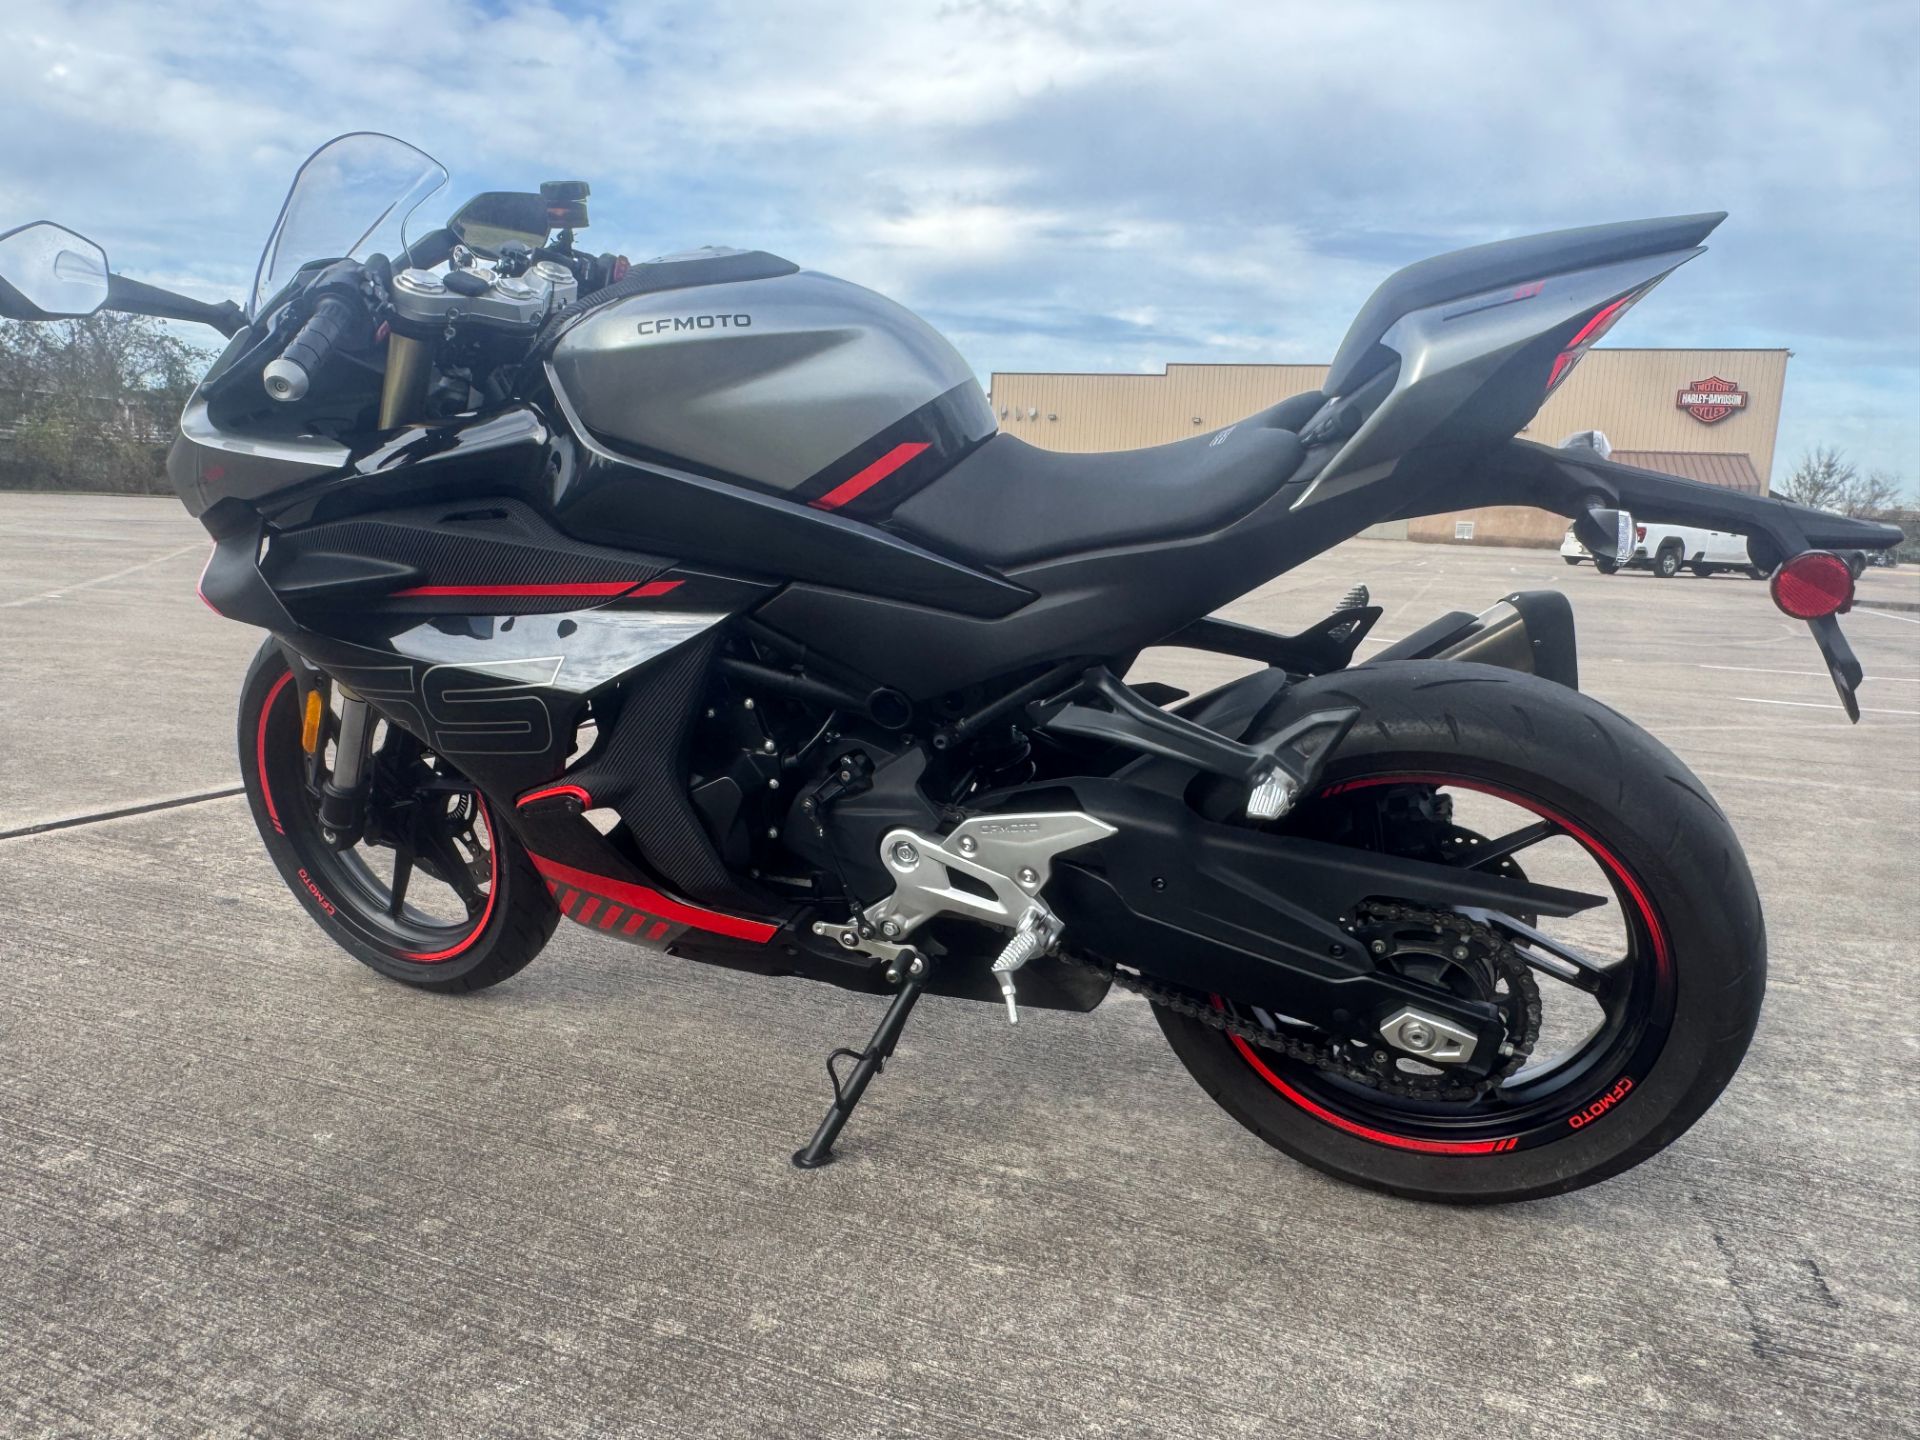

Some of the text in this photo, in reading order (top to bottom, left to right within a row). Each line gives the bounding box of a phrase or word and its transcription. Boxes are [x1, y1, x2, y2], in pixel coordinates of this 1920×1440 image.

[637, 314, 752, 335] CFMOTO
[1681, 393, 1743, 405] HARLEY-DAVIDSON
[981, 823, 1039, 835] CFMOTO
[298, 868, 335, 916] CFMOTO
[1568, 1077, 1633, 1129] CFMOTO
